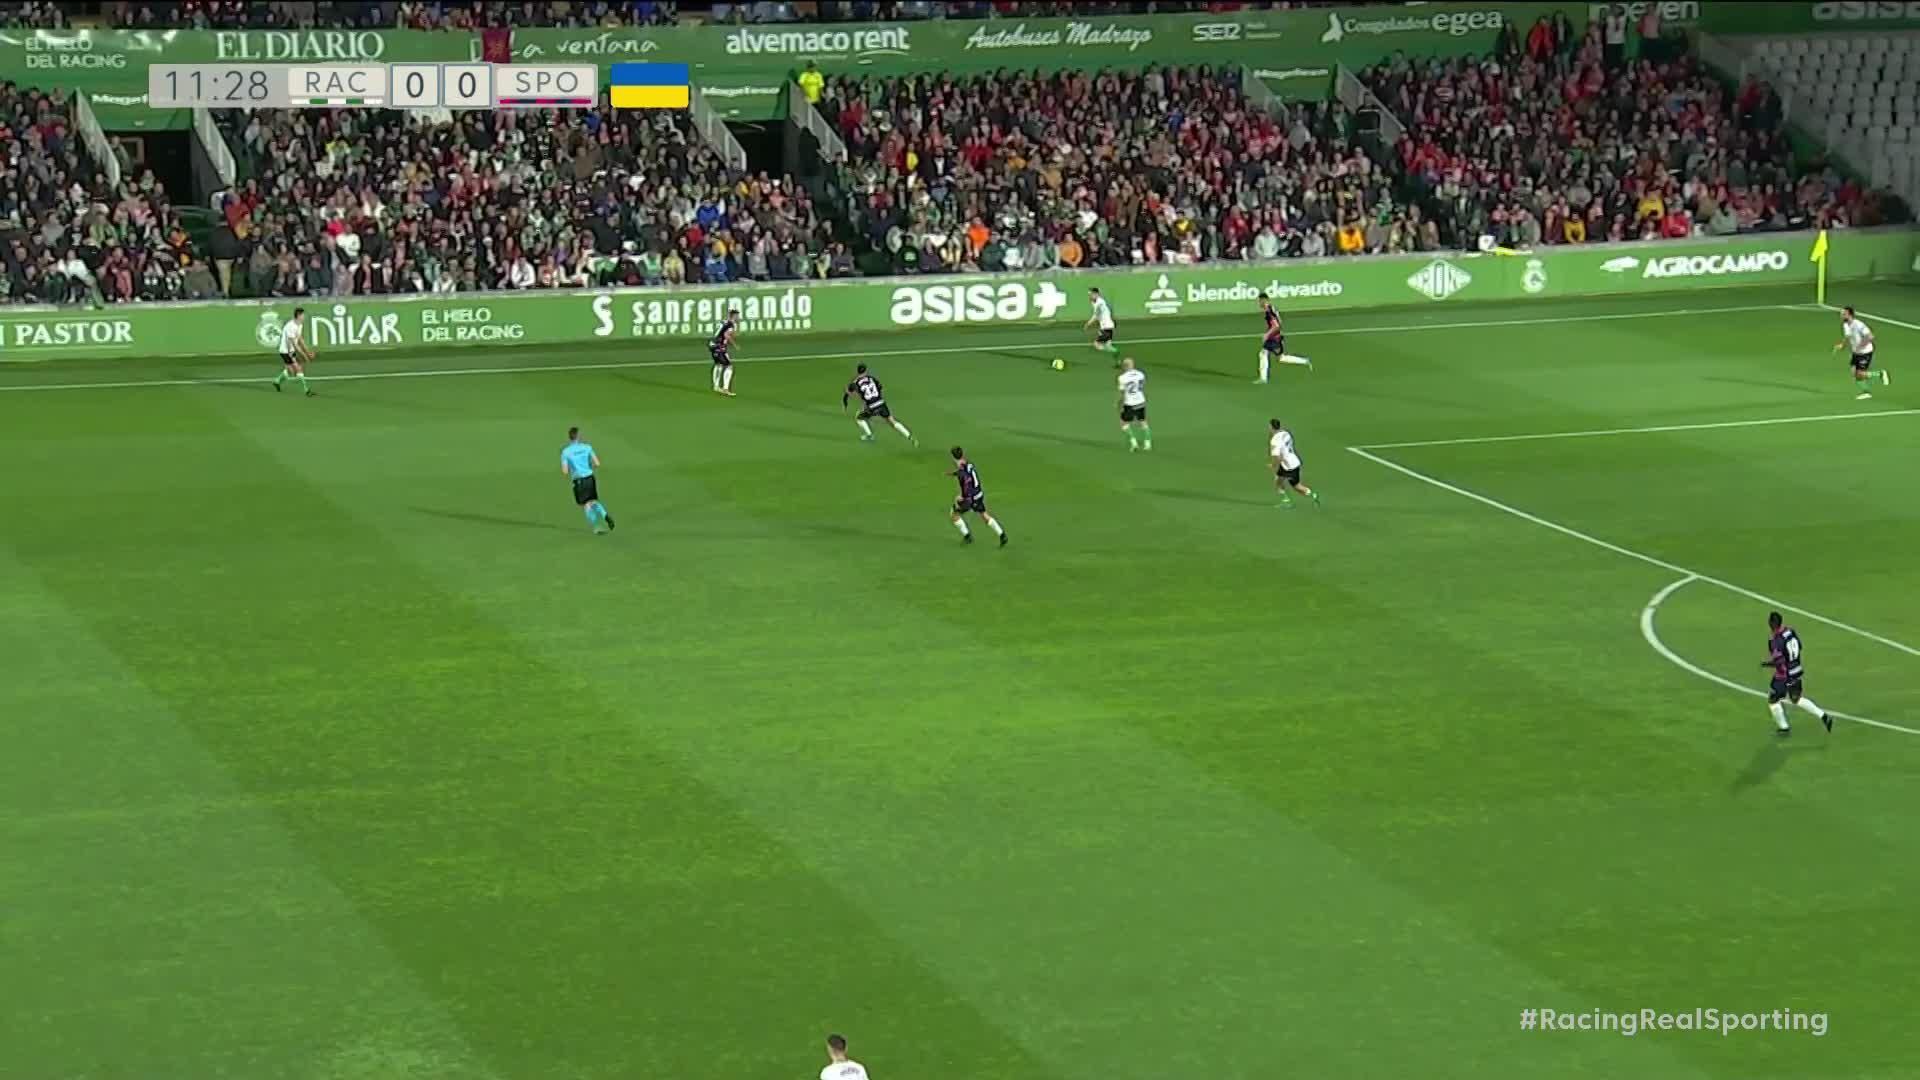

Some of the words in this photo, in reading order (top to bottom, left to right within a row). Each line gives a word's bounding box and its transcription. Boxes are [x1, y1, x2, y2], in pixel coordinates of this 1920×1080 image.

[1193, 23, 1241, 41] SER
[1431, 11, 1503, 36] egea
[216, 32, 260, 59] EL
[265, 31, 385, 59] DIARIO
[556, 32, 659, 55] ventana
[964, 23, 1061, 49] Autobuses
[1065, 22, 1153, 51] Madrazo
[26, 54, 56, 68] DEL
[60, 53, 127, 69] RACING
[1642, 250, 1789, 278] AGROCAMPO
[1187, 281, 1260, 302] blendio
[1264, 280, 1343, 299] devauto
[421, 309, 441, 324] EL
[443, 307, 492, 324] HIELO
[631, 288, 813, 324] sanfernando
[14, 321, 135, 346] PASTOR
[421, 327, 454, 342] DEL
[457, 323, 525, 342] RACING
[632, 322, 691, 337] GRUPO
